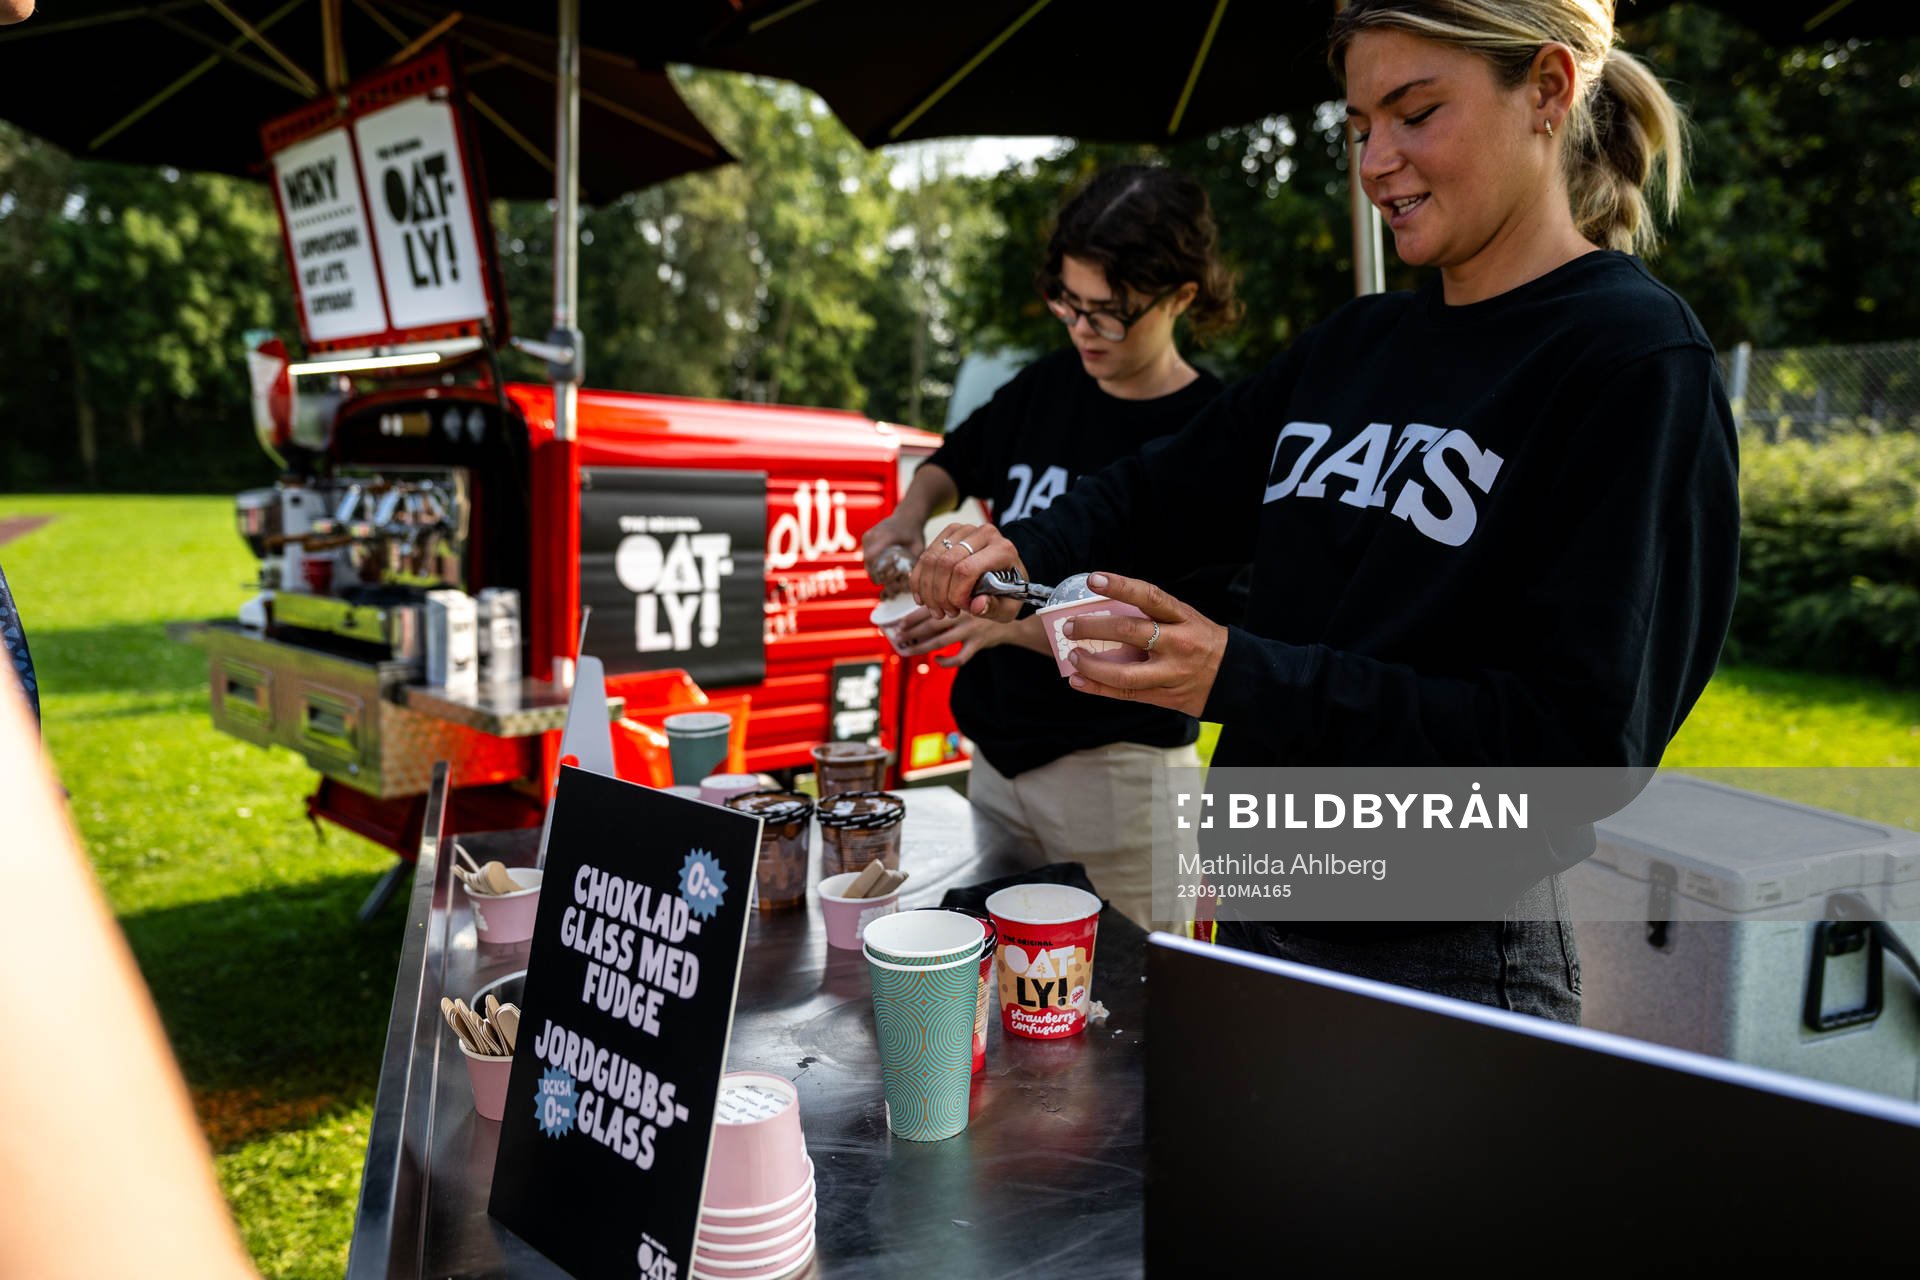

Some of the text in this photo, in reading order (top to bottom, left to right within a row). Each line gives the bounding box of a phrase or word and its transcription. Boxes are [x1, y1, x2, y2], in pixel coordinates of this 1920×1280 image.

[382, 152, 456, 226] OAT-
[403, 223, 461, 290] LY!
[999, 463, 1069, 527] OA
[1262, 421, 1505, 547] OATS
[615, 533, 734, 594] OAT-
[635, 591, 721, 652] LY!
[574, 863, 702, 943] CHOKLAD-
[560, 906, 700, 999] GLASS MED
[1004, 944, 1077, 979] OAT-
[582, 961, 665, 1037] FUDGE
[1011, 1009, 1077, 1024] strawberry
[1016, 976, 1068, 1009] LY!
[1011, 1020, 1070, 1036] confusion
[534, 1019, 690, 1129] JORDGUBBS-
[577, 1089, 658, 1171] GLASS
